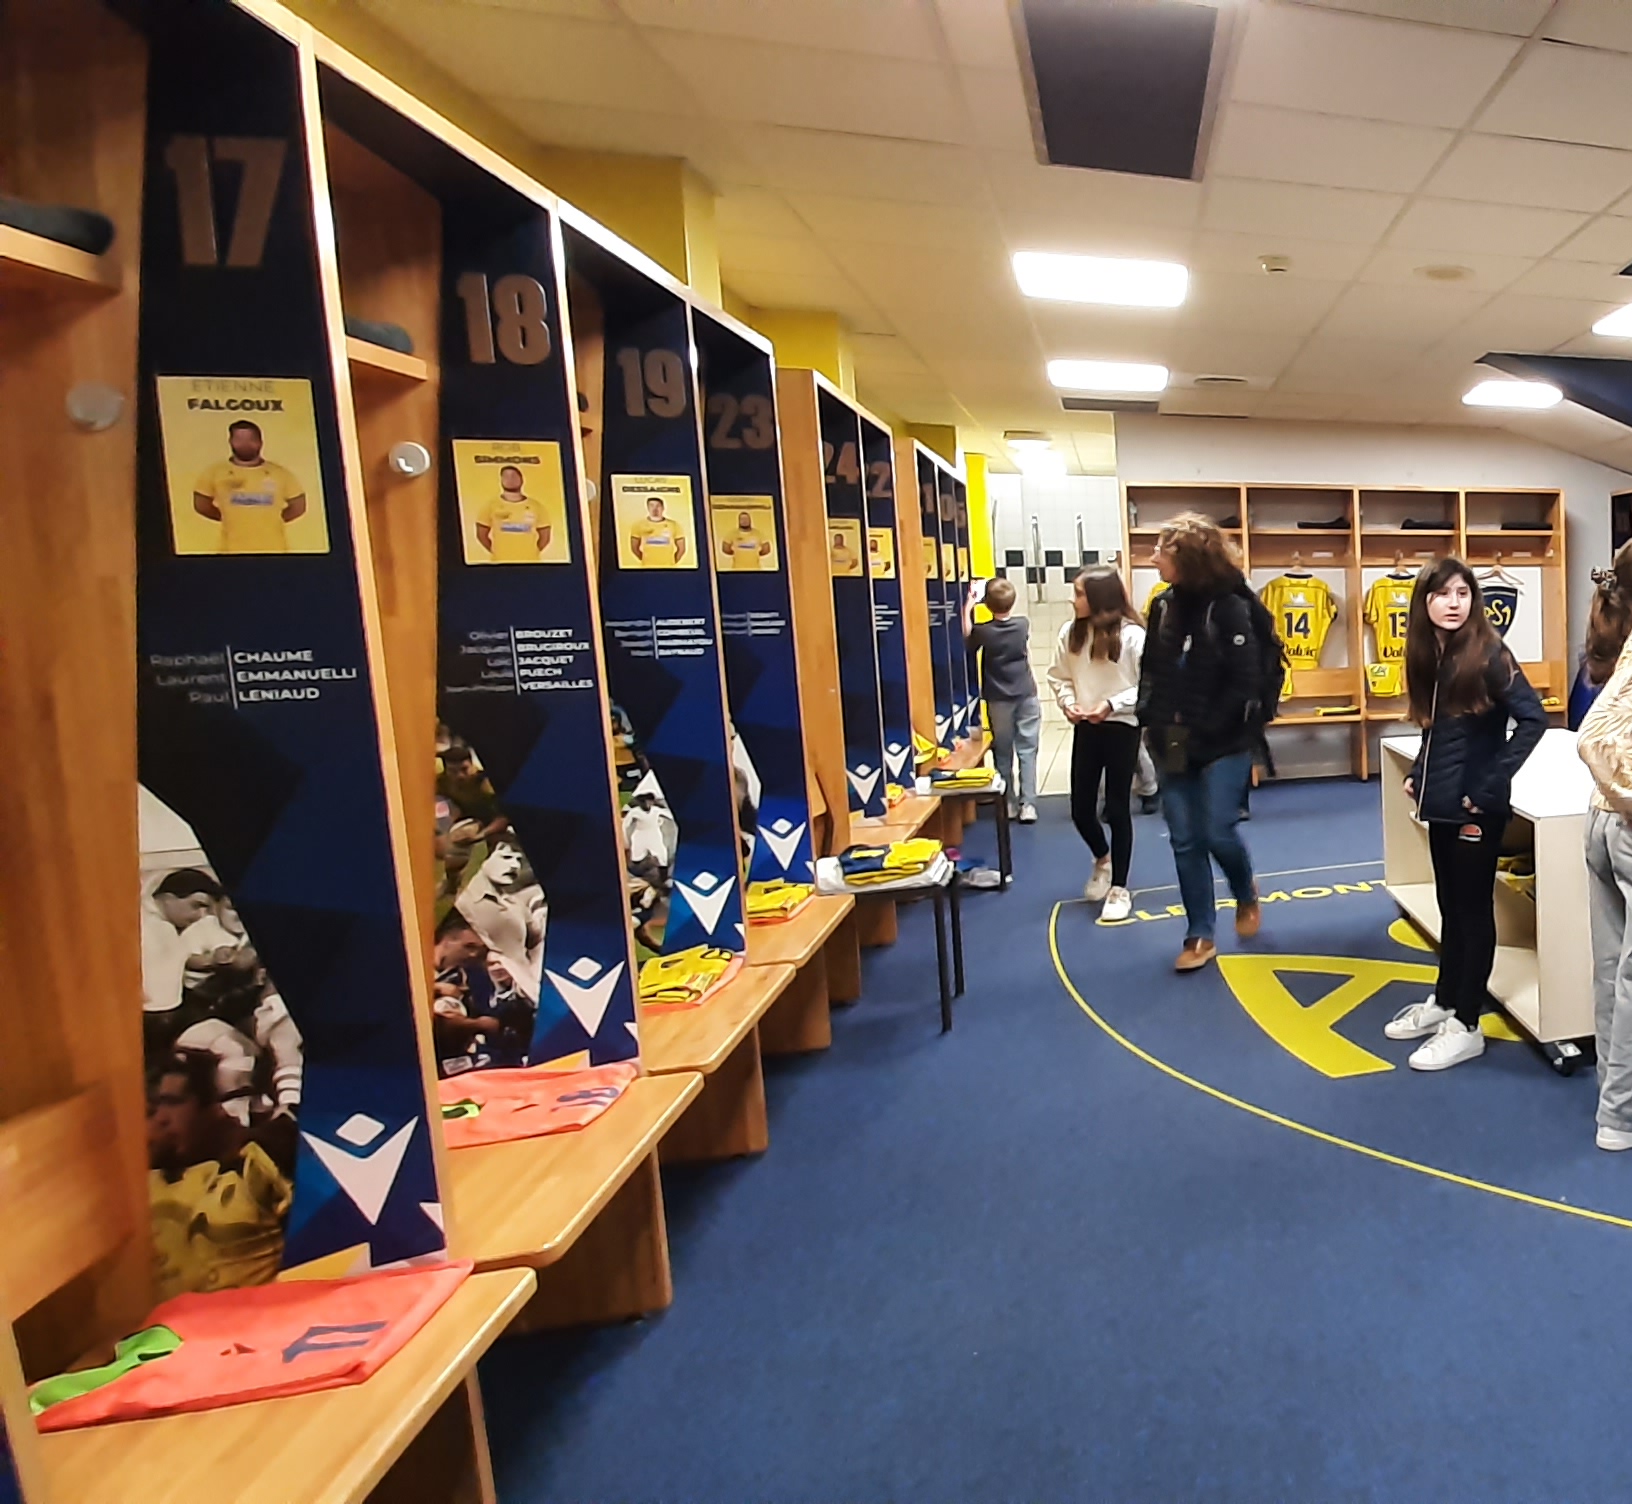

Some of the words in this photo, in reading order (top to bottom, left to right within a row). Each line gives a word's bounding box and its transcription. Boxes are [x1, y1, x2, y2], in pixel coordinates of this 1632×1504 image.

[164, 135, 289, 268] 17
[457, 272, 551, 366] 18
[192, 380, 274, 393] ETIENNE
[617, 347, 687, 418] 19
[708, 394, 774, 449] 23
[1284, 612, 1311, 638] 14
[1388, 612, 1408, 638] 13
[234, 650, 314, 665] CHAUME
[156, 673, 227, 687] Laurent
[237, 668, 358, 684] EMMANUELLI
[189, 690, 230, 704] Paul
[239, 687, 321, 702] LENIAUD
